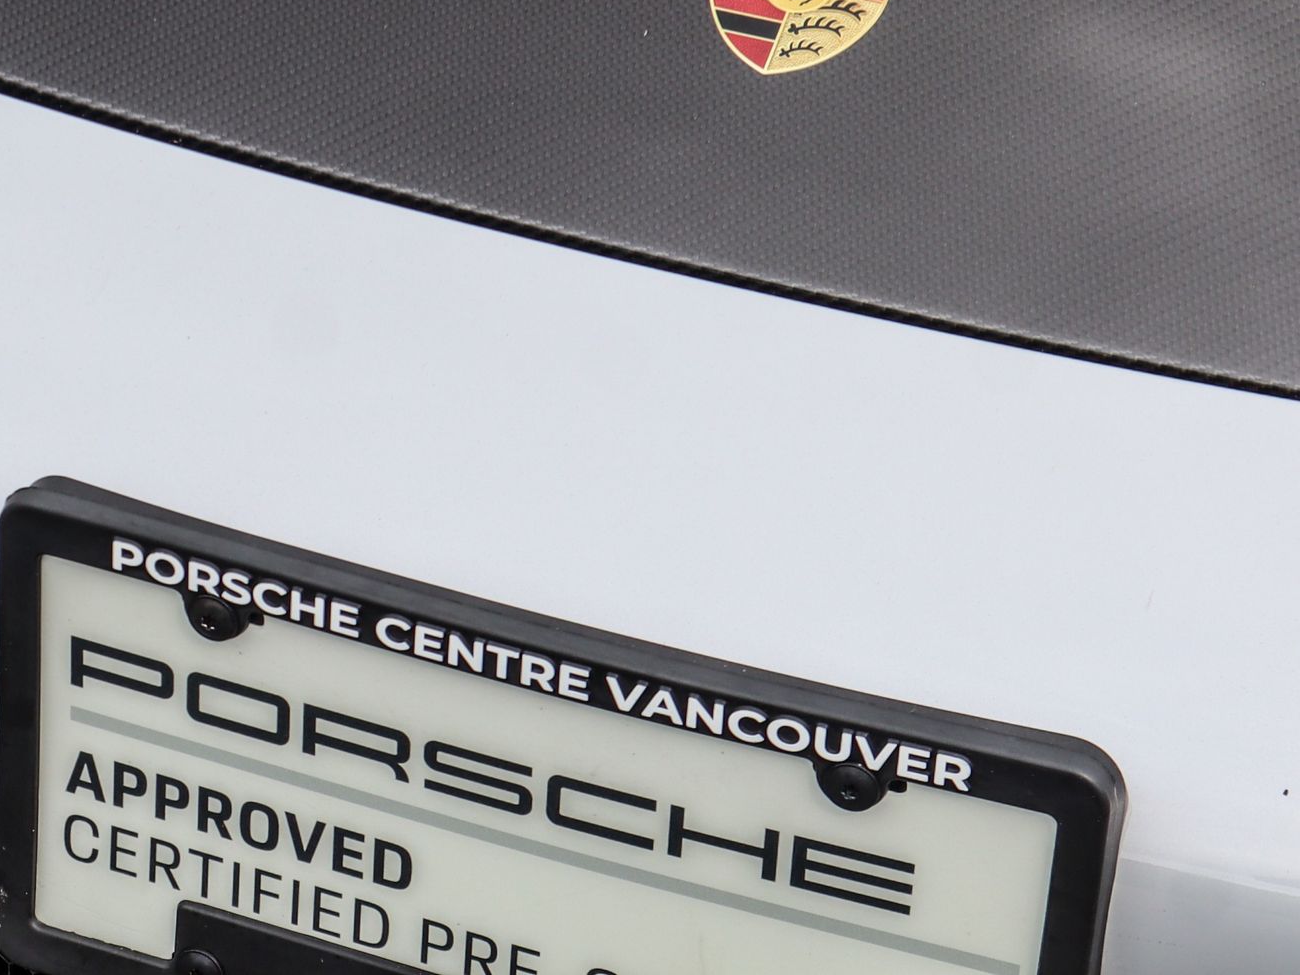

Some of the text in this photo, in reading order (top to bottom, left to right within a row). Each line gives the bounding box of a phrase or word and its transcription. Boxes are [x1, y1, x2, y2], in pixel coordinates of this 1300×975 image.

[111, 539, 972, 792] PORSCHE CENTRE VANCOUVER
[65, 750, 413, 890] APPROVED
[70, 635, 916, 916] PORSCHE
[63, 814, 390, 949] CERTIFIED
